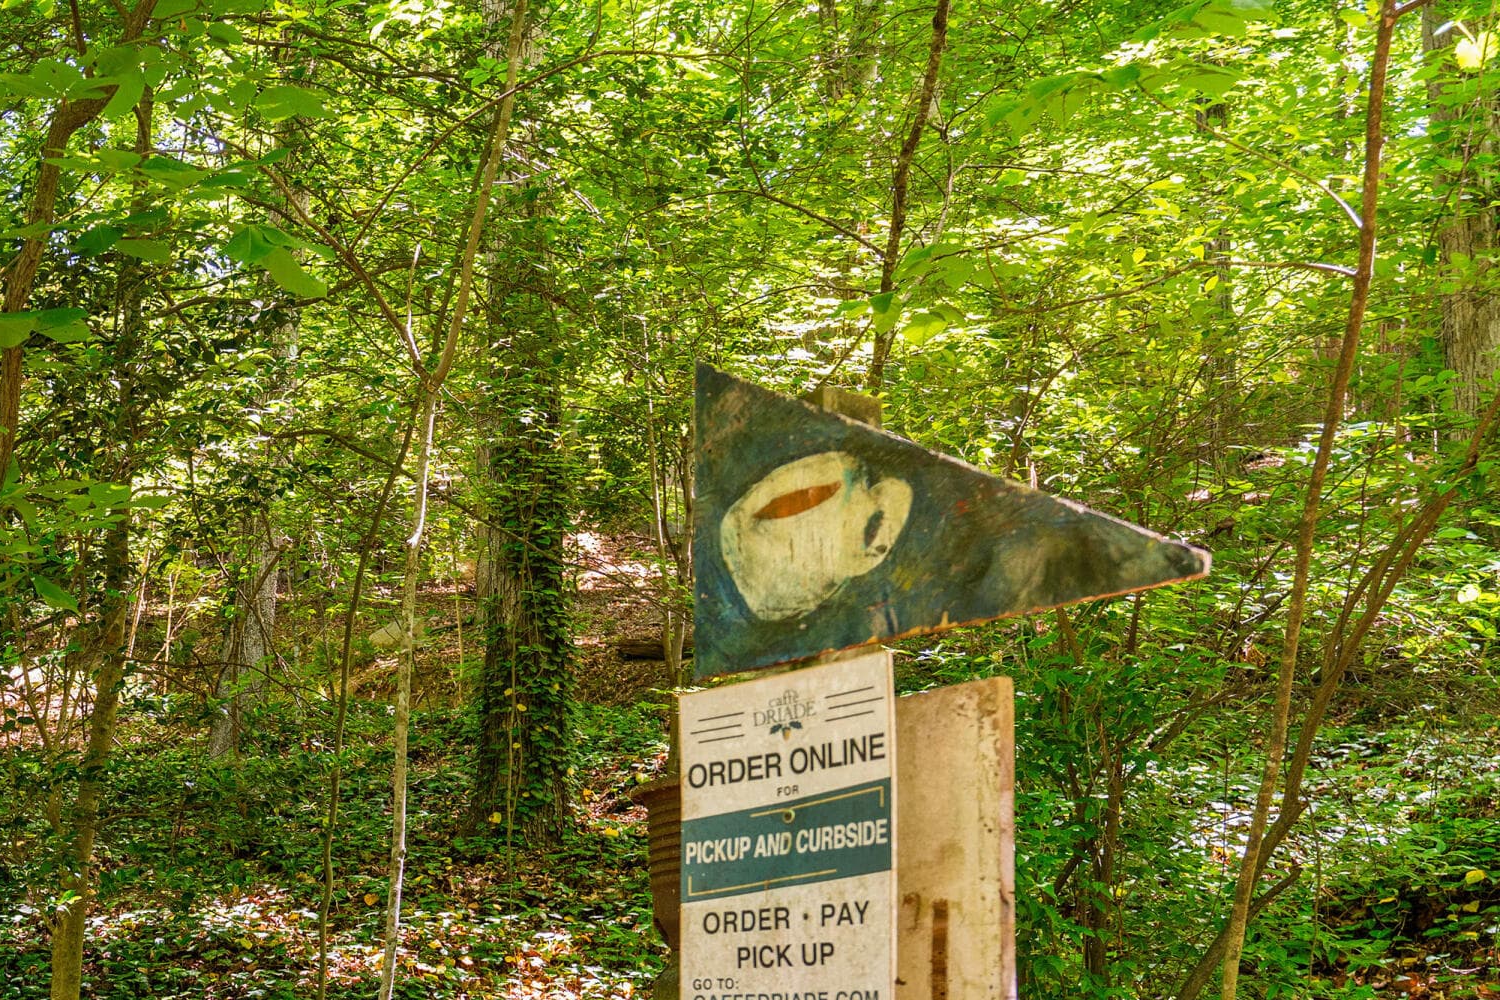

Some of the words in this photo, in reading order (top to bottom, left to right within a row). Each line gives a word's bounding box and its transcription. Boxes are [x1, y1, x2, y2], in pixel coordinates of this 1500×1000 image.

[753, 700, 817, 727] DRIADE
[688, 752, 781, 789] ORDER
[789, 732, 886, 775] ONLINE
[776, 785, 799, 797] FOR
[685, 836, 751, 865] PICKUP
[753, 831, 793, 859] AND
[795, 818, 888, 853] CURBSIDE
[703, 906, 790, 935] ORDER
[821, 900, 870, 927] PAY
[737, 944, 793, 969] PICK
[802, 942, 835, 967] UP
[692, 978, 713, 991] GO
[716, 977, 740, 990] TO:
